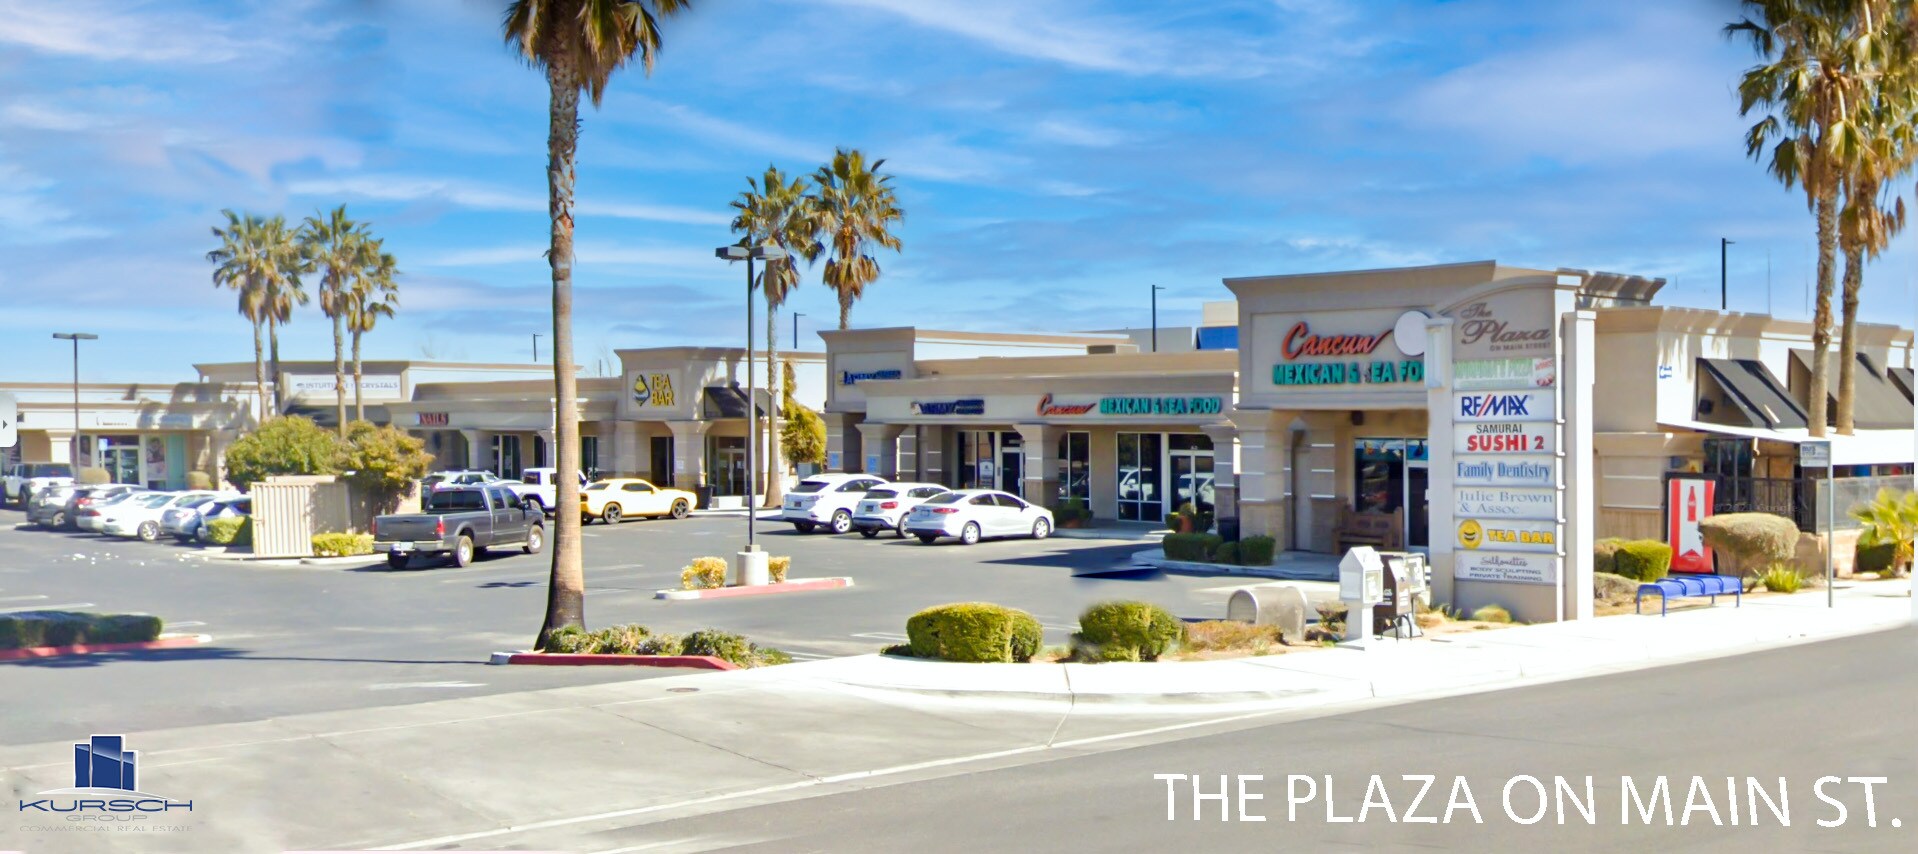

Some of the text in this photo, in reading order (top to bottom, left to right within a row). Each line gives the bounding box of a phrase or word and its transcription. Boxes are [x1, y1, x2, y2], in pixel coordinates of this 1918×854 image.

[1461, 302, 1492, 319] The
[1281, 321, 1394, 360] Cancun
[1461, 320, 1551, 344] Plaza
[651, 373, 671, 390] TEA
[1272, 363, 1345, 385] MEXICAN
[651, 390, 674, 406] BAR
[1100, 397, 1149, 415] MEXICAN
[1163, 397, 1186, 414] SEA
[1188, 397, 1222, 414] FOOD
[1461, 394, 1529, 417] RE/MAX
[1476, 424, 1522, 434] SAMURAI
[1467, 434, 1544, 452] SUSHI 2
[1457, 461, 1551, 482] Family Dentistry
[1459, 490, 1552, 503] Julie Brown
[1459, 503, 1470, 513] &
[1487, 529, 1554, 544] TEA BAR
